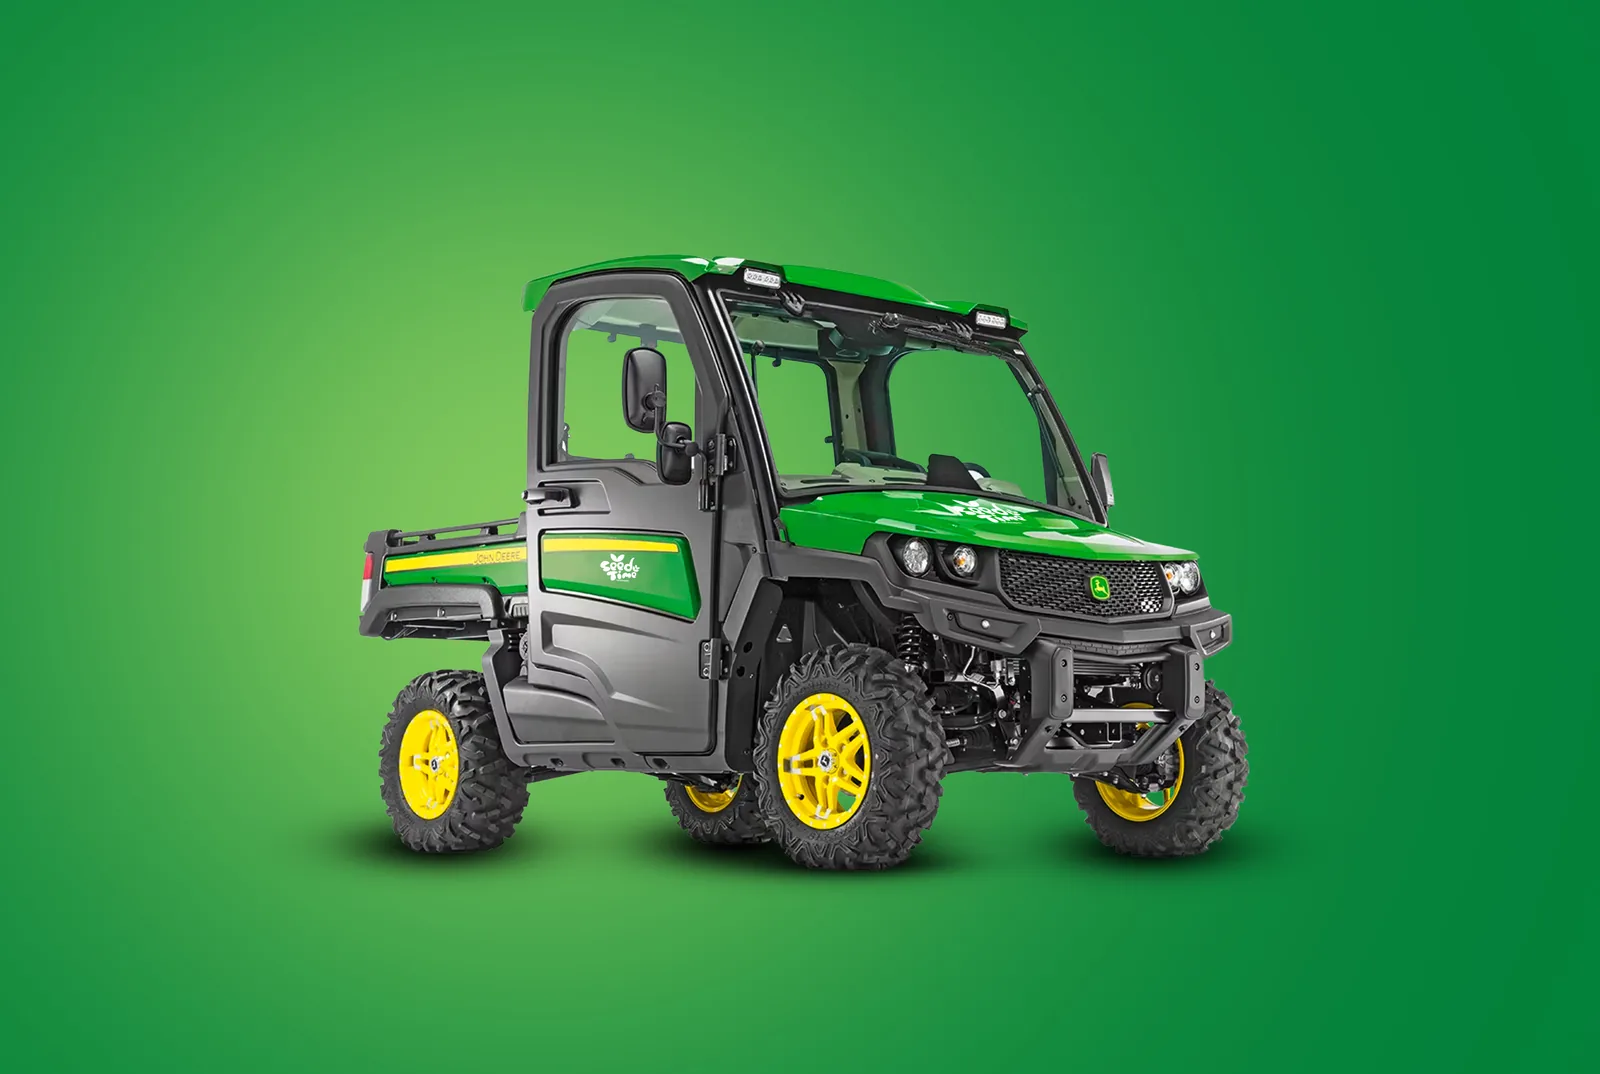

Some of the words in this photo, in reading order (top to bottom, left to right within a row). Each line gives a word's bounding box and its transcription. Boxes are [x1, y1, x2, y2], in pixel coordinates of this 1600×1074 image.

[474, 553, 494, 563] JOHN
[496, 551, 520, 561] DEERE
[600, 557, 635, 572] Seed
[606, 570, 637, 581] Time
